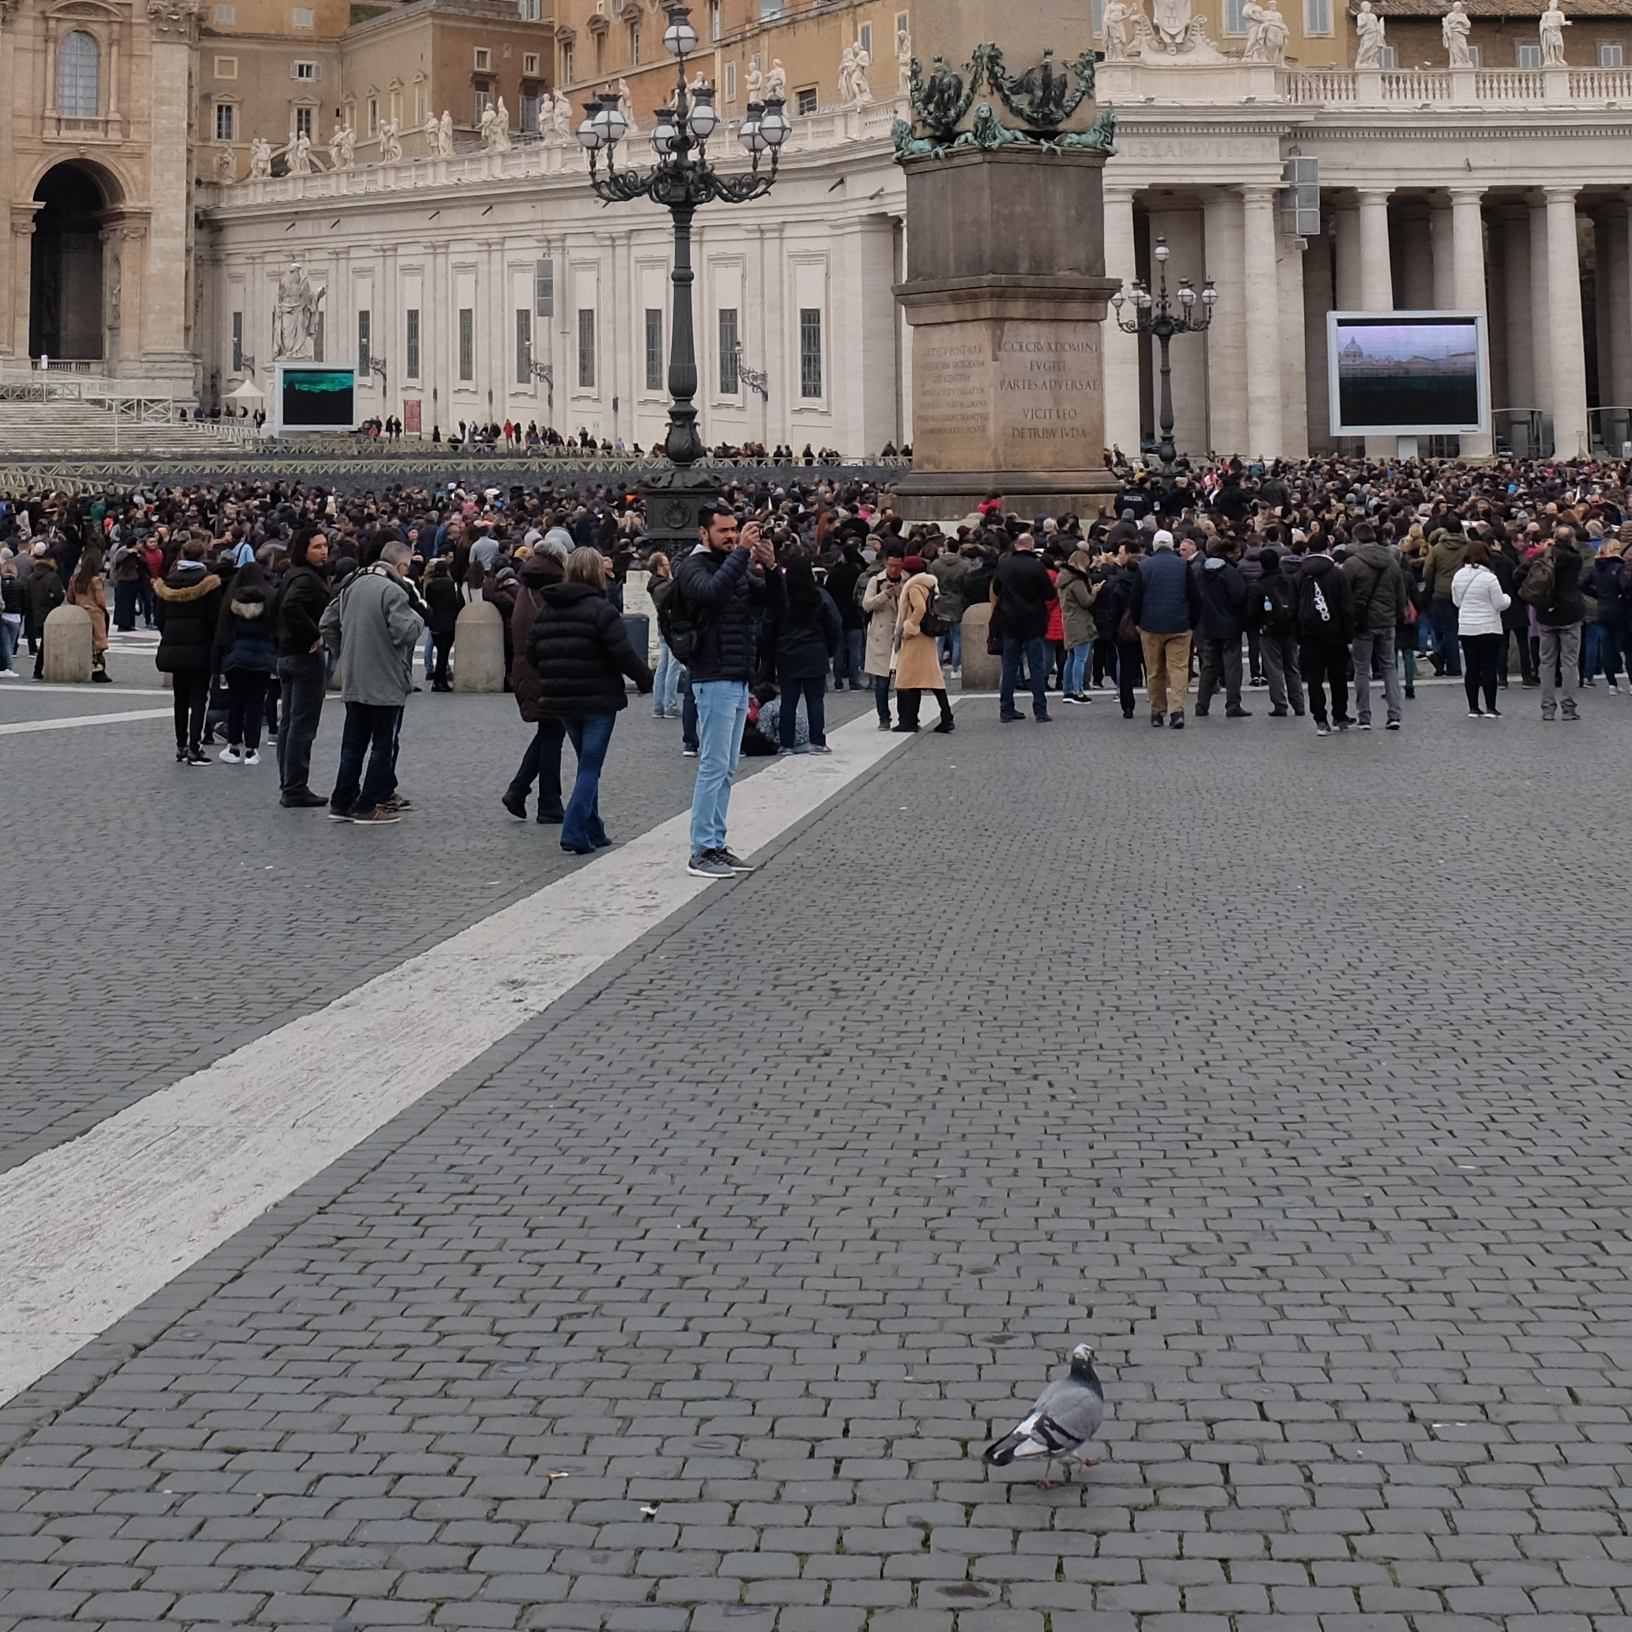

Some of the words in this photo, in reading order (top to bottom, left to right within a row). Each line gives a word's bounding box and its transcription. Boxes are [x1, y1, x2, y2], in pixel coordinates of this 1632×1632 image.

[1055, 341, 1098, 353] DOMINI
[1000, 380, 1038, 390] PARTES
[1022, 408, 1054, 419] VICIT
[1056, 408, 1077, 419] LEO
[1012, 428, 1025, 439] DE
[1027, 427, 1057, 439] TRIBV
[1060, 427, 1087, 439] IVDA
